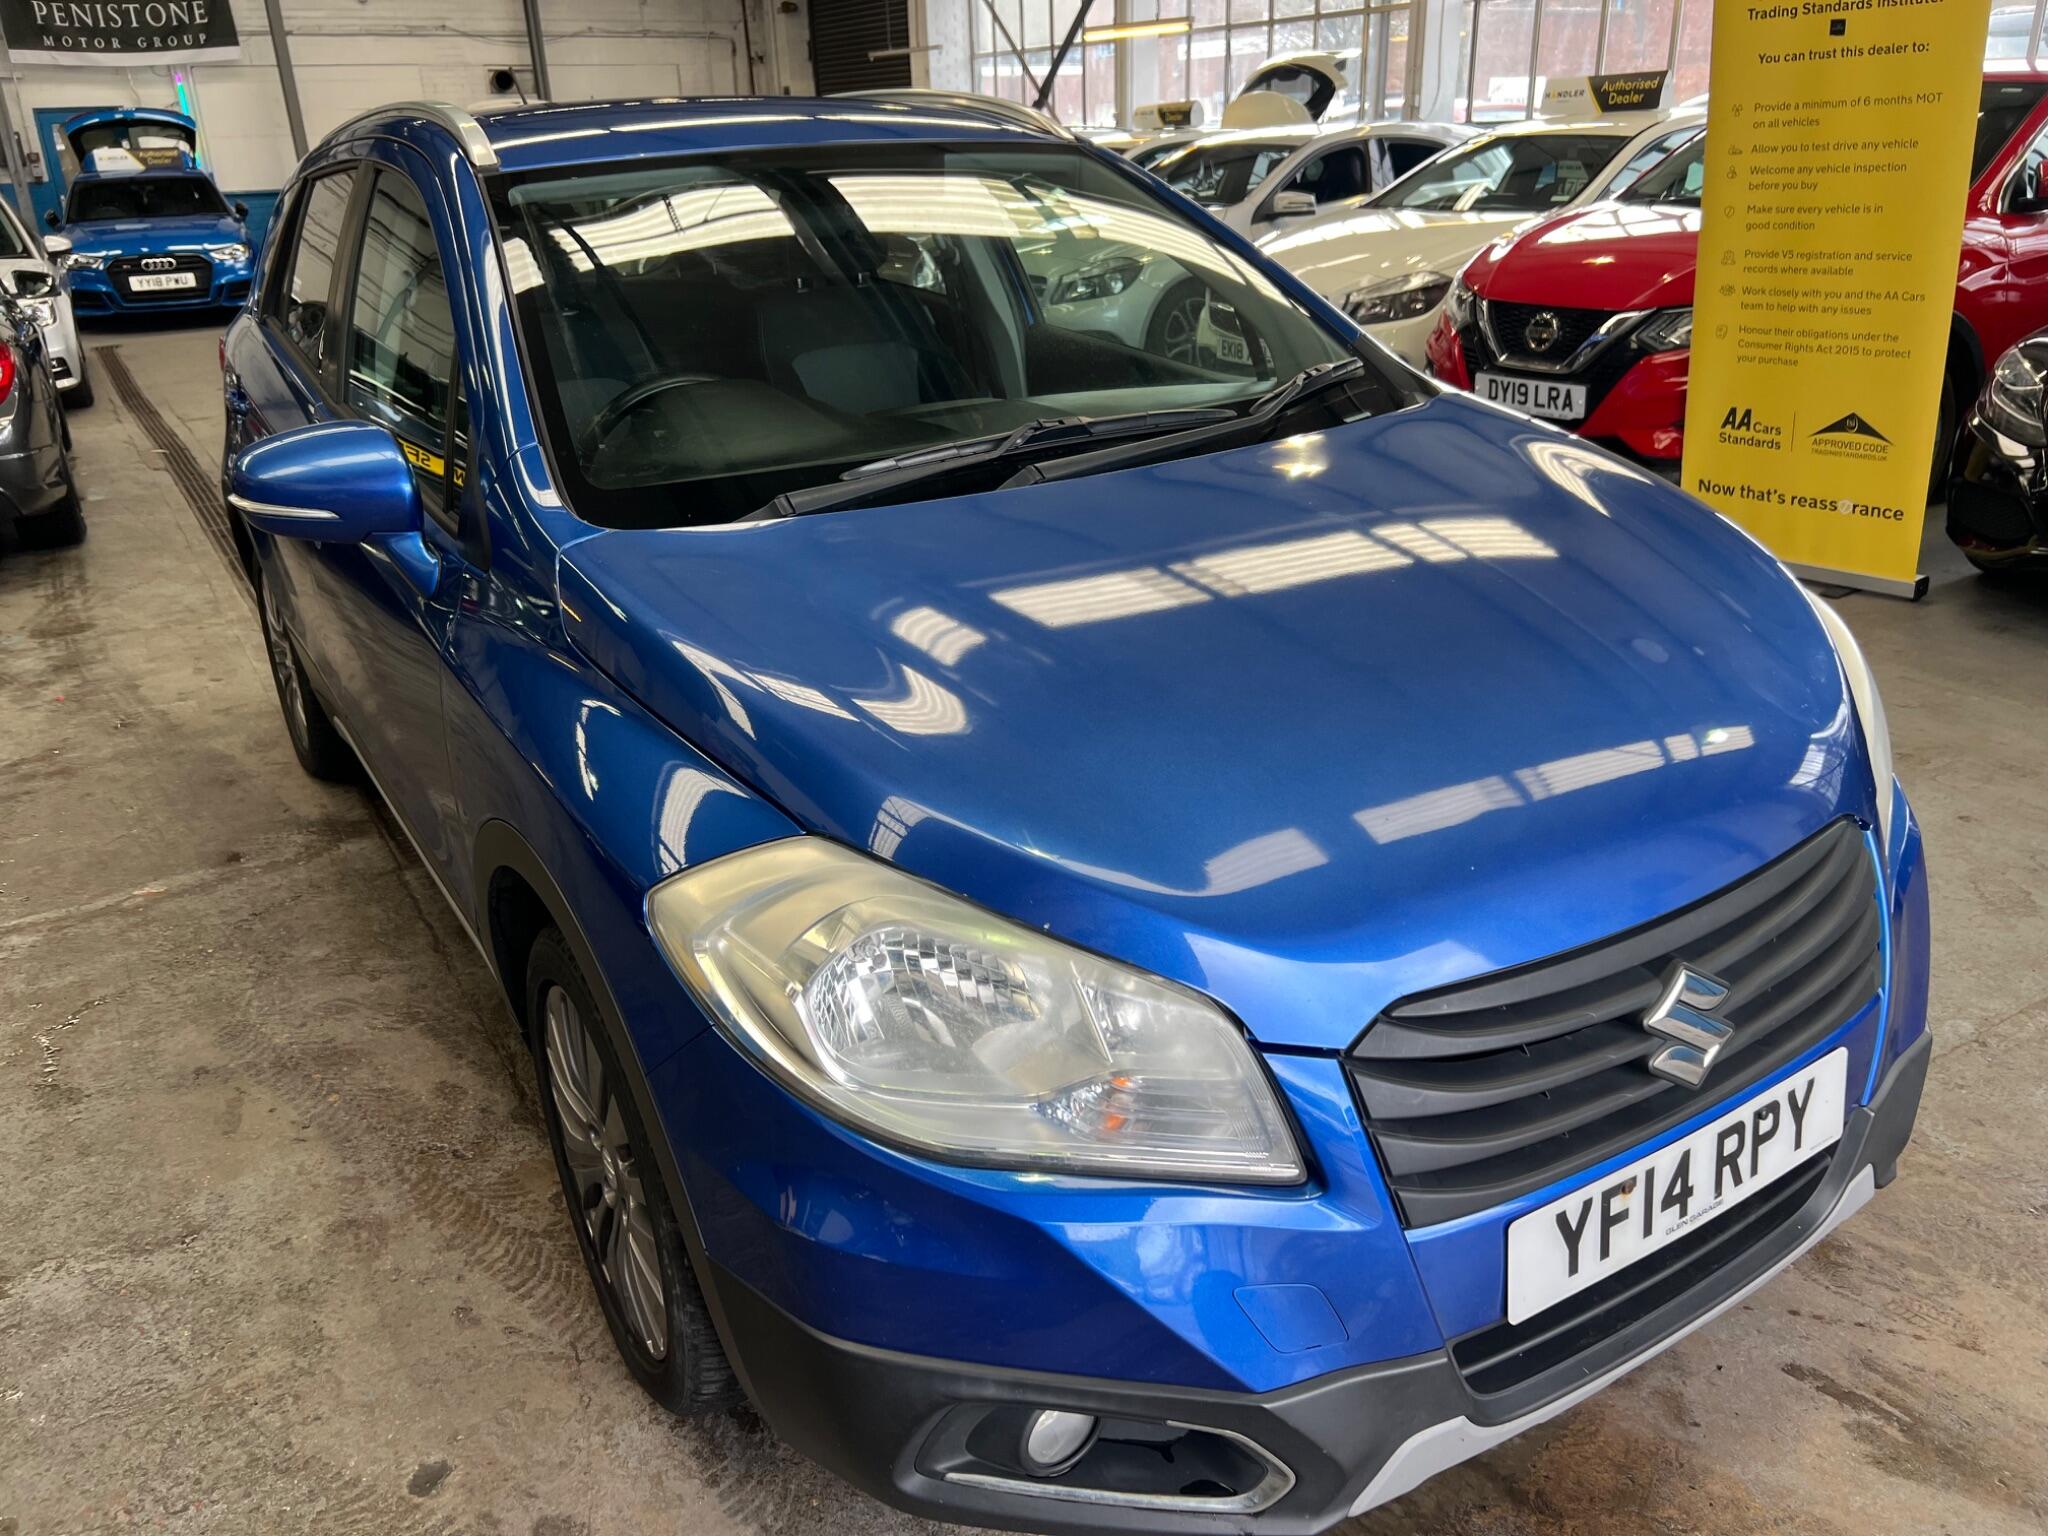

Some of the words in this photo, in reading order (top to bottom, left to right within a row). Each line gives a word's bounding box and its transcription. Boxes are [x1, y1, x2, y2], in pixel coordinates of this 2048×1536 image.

[32, 1, 208, 28] PENISTONE
[1747, 5, 1798, 20] Trading
[1802, 0, 1873, 15] Standards
[43, 35, 121, 49] MOTOR
[137, 33, 208, 48] GROUP
[1759, 53, 1780, 64] You
[1784, 51, 1805, 62] can
[1809, 49, 1837, 60] trust
[1840, 46, 1864, 58] this
[1868, 43, 1908, 56] dealer
[1912, 42, 1930, 53] to:
[1601, 76, 1660, 92] Authorised
[1608, 91, 1645, 105] Dealer
[1754, 100, 1792, 113] Provide
[1802, 99, 1848, 110] minimum
[1850, 97, 1862, 108] of
[1863, 96, 1871, 106] 6
[1873, 94, 1913, 106] months
[1916, 92, 1944, 103] MOT
[1752, 120, 1765, 129] on
[1768, 118, 1780, 128] all
[1782, 116, 1820, 128] vehicles
[1751, 143, 1778, 154] Allow
[1780, 145, 1798, 155] you
[1800, 143, 1810, 153] to
[1812, 142, 1830, 152] test
[1833, 140, 1858, 151] drive
[1861, 141, 1880, 153] any
[1882, 138, 1919, 149] vehicle
[1750, 165, 1795, 176] Welcome
[1796, 167, 1813, 177] any
[1815, 163, 1850, 174] vehicle
[1853, 162, 1907, 175] inspection
[1748, 181, 1780, 191] before
[1782, 182, 1798, 192] you
[1800, 180, 1818, 192] buy
[1746, 204, 1773, 214] Make
[1775, 206, 1795, 214] sure
[1797, 206, 1822, 216] every
[1824, 203, 1860, 214] vehicle
[1863, 203, 1872, 213] is
[1873, 203, 1883, 213] in
[1745, 220, 1770, 232] good
[1772, 219, 1815, 231] condition
[1744, 249, 1780, 260] Provide
[1782, 250, 1794, 259] V5
[1796, 249, 1851, 262] registration
[1854, 251, 1873, 261] and
[1875, 252, 1913, 262] service
[1743, 265, 1778, 274] records
[1780, 265, 1807, 275] where
[1810, 266, 1854, 276] available
[1741, 286, 1766, 296] Work
[1768, 287, 1799, 299] closely
[1801, 288, 1822, 298] with
[1824, 291, 1842, 300] you
[1844, 290, 1863, 300] and
[1866, 290, 1882, 300] the
[1883, 291, 1899, 301] AA
[1901, 292, 1926, 302] Cars
[1740, 303, 1763, 311] team
[1765, 303, 1775, 311] to
[1777, 303, 1796, 313] help
[1798, 303, 1819, 313] with
[1821, 306, 1838, 315] any
[1840, 305, 1872, 315] issues
[1738, 325, 1772, 336] Honour
[1774, 327, 1793, 337] their
[1796, 328, 1849, 341] obligations
[1851, 331, 1880, 342] under
[1882, 333, 1899, 343] the
[1737, 339, 1782, 351] Consumer
[1785, 342, 1814, 354] Rights
[1816, 344, 1833, 355] Act
[1835, 345, 1860, 356] 2015
[1862, 346, 1872, 357] to
[1874, 348, 1911, 359] protect
[1736, 354, 1757, 364] your
[1758, 356, 1799, 367] purchase
[1488, 378, 1529, 406] DY19
[1534, 384, 1573, 413] LRA
[1720, 406, 1752, 433] AA
[1753, 421, 1782, 437] Cars
[1718, 432, 1781, 451] Standards
[1811, 438, 1862, 452] APPROVED
[1862, 443, 1889, 455] CODE
[1698, 478, 1735, 497] Now
[1740, 484, 1786, 505] that's
[1790, 494, 1905, 521] reassrance
[1555, 1149, 1694, 1278] YF14
[1714, 1076, 1815, 1199] RPY
